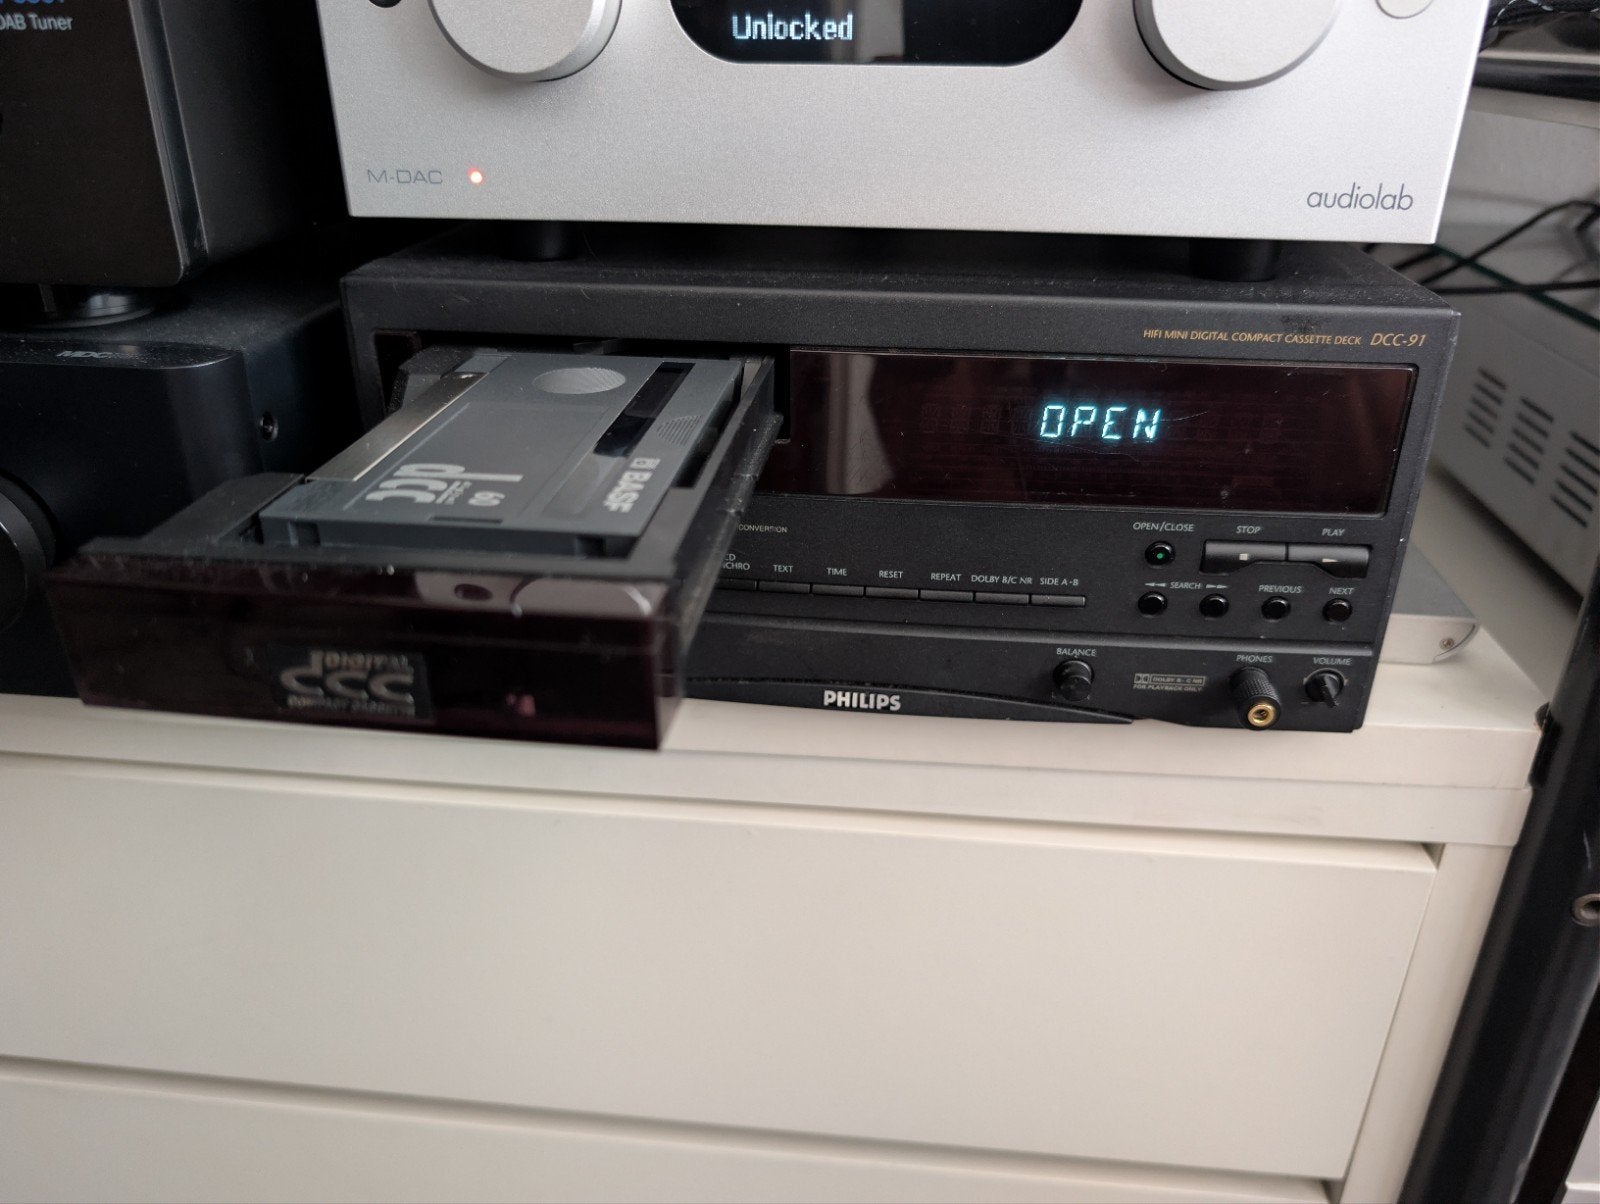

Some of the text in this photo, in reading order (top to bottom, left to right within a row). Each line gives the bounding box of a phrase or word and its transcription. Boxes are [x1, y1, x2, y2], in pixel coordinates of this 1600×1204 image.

[27, 12, 73, 31] Tuner
[732, 11, 853, 41] Unlocked
[367, 169, 443, 185] M-DAC
[1306, 182, 1414, 211] audiolab
[1143, 329, 1427, 348] HIFI MINI DIGITAL COMPACT CASSETTE DECK DCC-91
[1038, 403, 1163, 441] OPEN
[603, 470, 653, 514] BASF
[1132, 521, 1196, 533] OPEN/CLOSE
[1235, 525, 1262, 535] STOP
[1321, 528, 1346, 537] PLAY
[773, 564, 794, 574] TEXT
[826, 567, 848, 577] TIME
[878, 570, 904, 580] RESET
[930, 572, 962, 582] REPEAT
[971, 574, 1033, 585] DOLBY B/C NR
[1039, 577, 1060, 587] SIDE
[1169, 581, 1202, 590] SEARCH
[1258, 584, 1303, 595] PREVIOUS
[1328, 587, 1355, 596] NEXT
[1055, 647, 1098, 658] BALANCE
[1235, 654, 1273, 664] PHONES
[1312, 656, 1352, 666] VOLUME
[823, 689, 902, 712] PHILIPS
